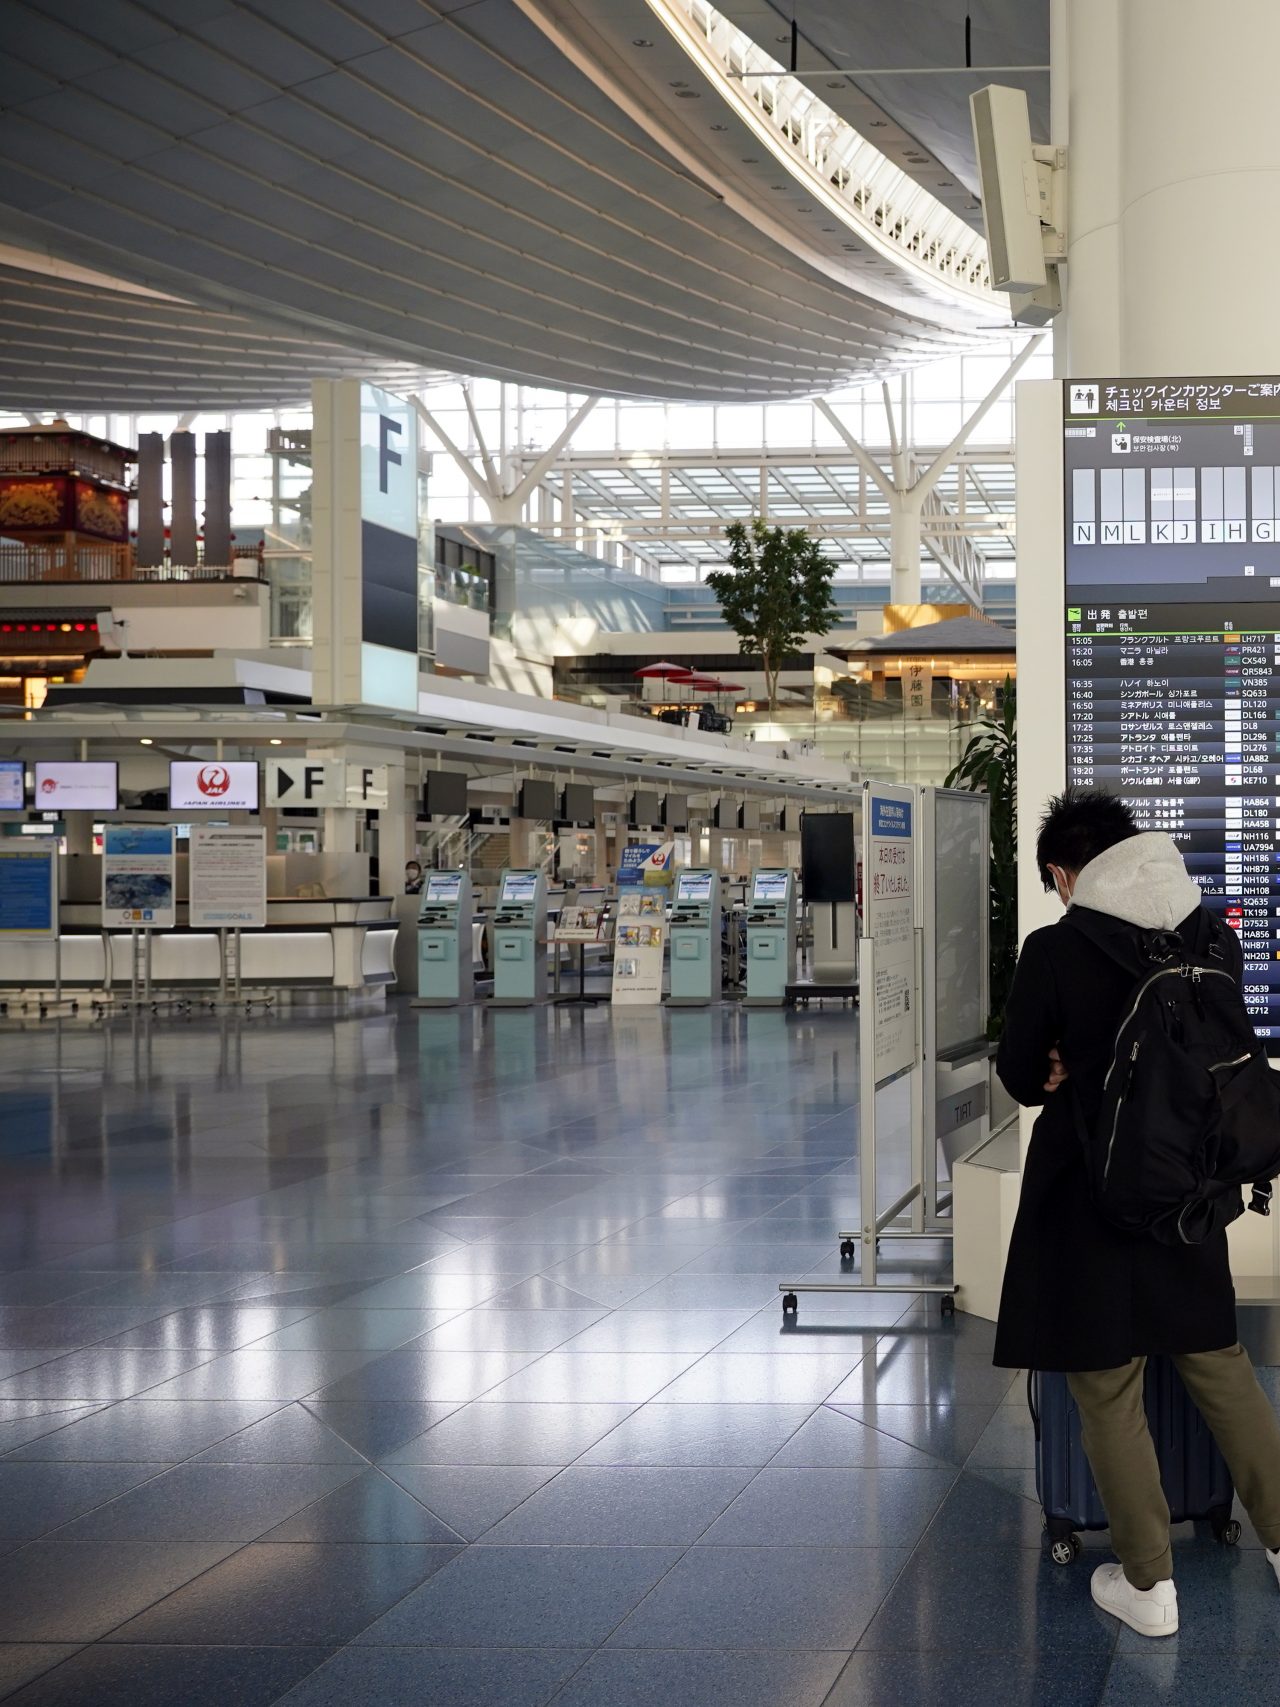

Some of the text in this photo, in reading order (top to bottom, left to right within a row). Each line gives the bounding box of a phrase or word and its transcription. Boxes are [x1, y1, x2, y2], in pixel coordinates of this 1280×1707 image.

[1106, 398, 1221, 412] 체크인 카운터 정보
[380, 414, 401, 494] F
[1079, 526, 1090, 541] N
[1105, 525, 1119, 540] M
[1131, 525, 1140, 540] L
[1157, 525, 1168, 540] K
[1181, 524, 1188, 540] J
[1229, 524, 1241, 539] H
[1256, 523, 1269, 539] G
[1118, 609, 1147, 619] 출발편
[1121, 690, 1163, 698] シンガポール
[1121, 766, 1163, 774] ポートランド
[305, 767, 324, 799] F
[363, 769, 372, 800] F
